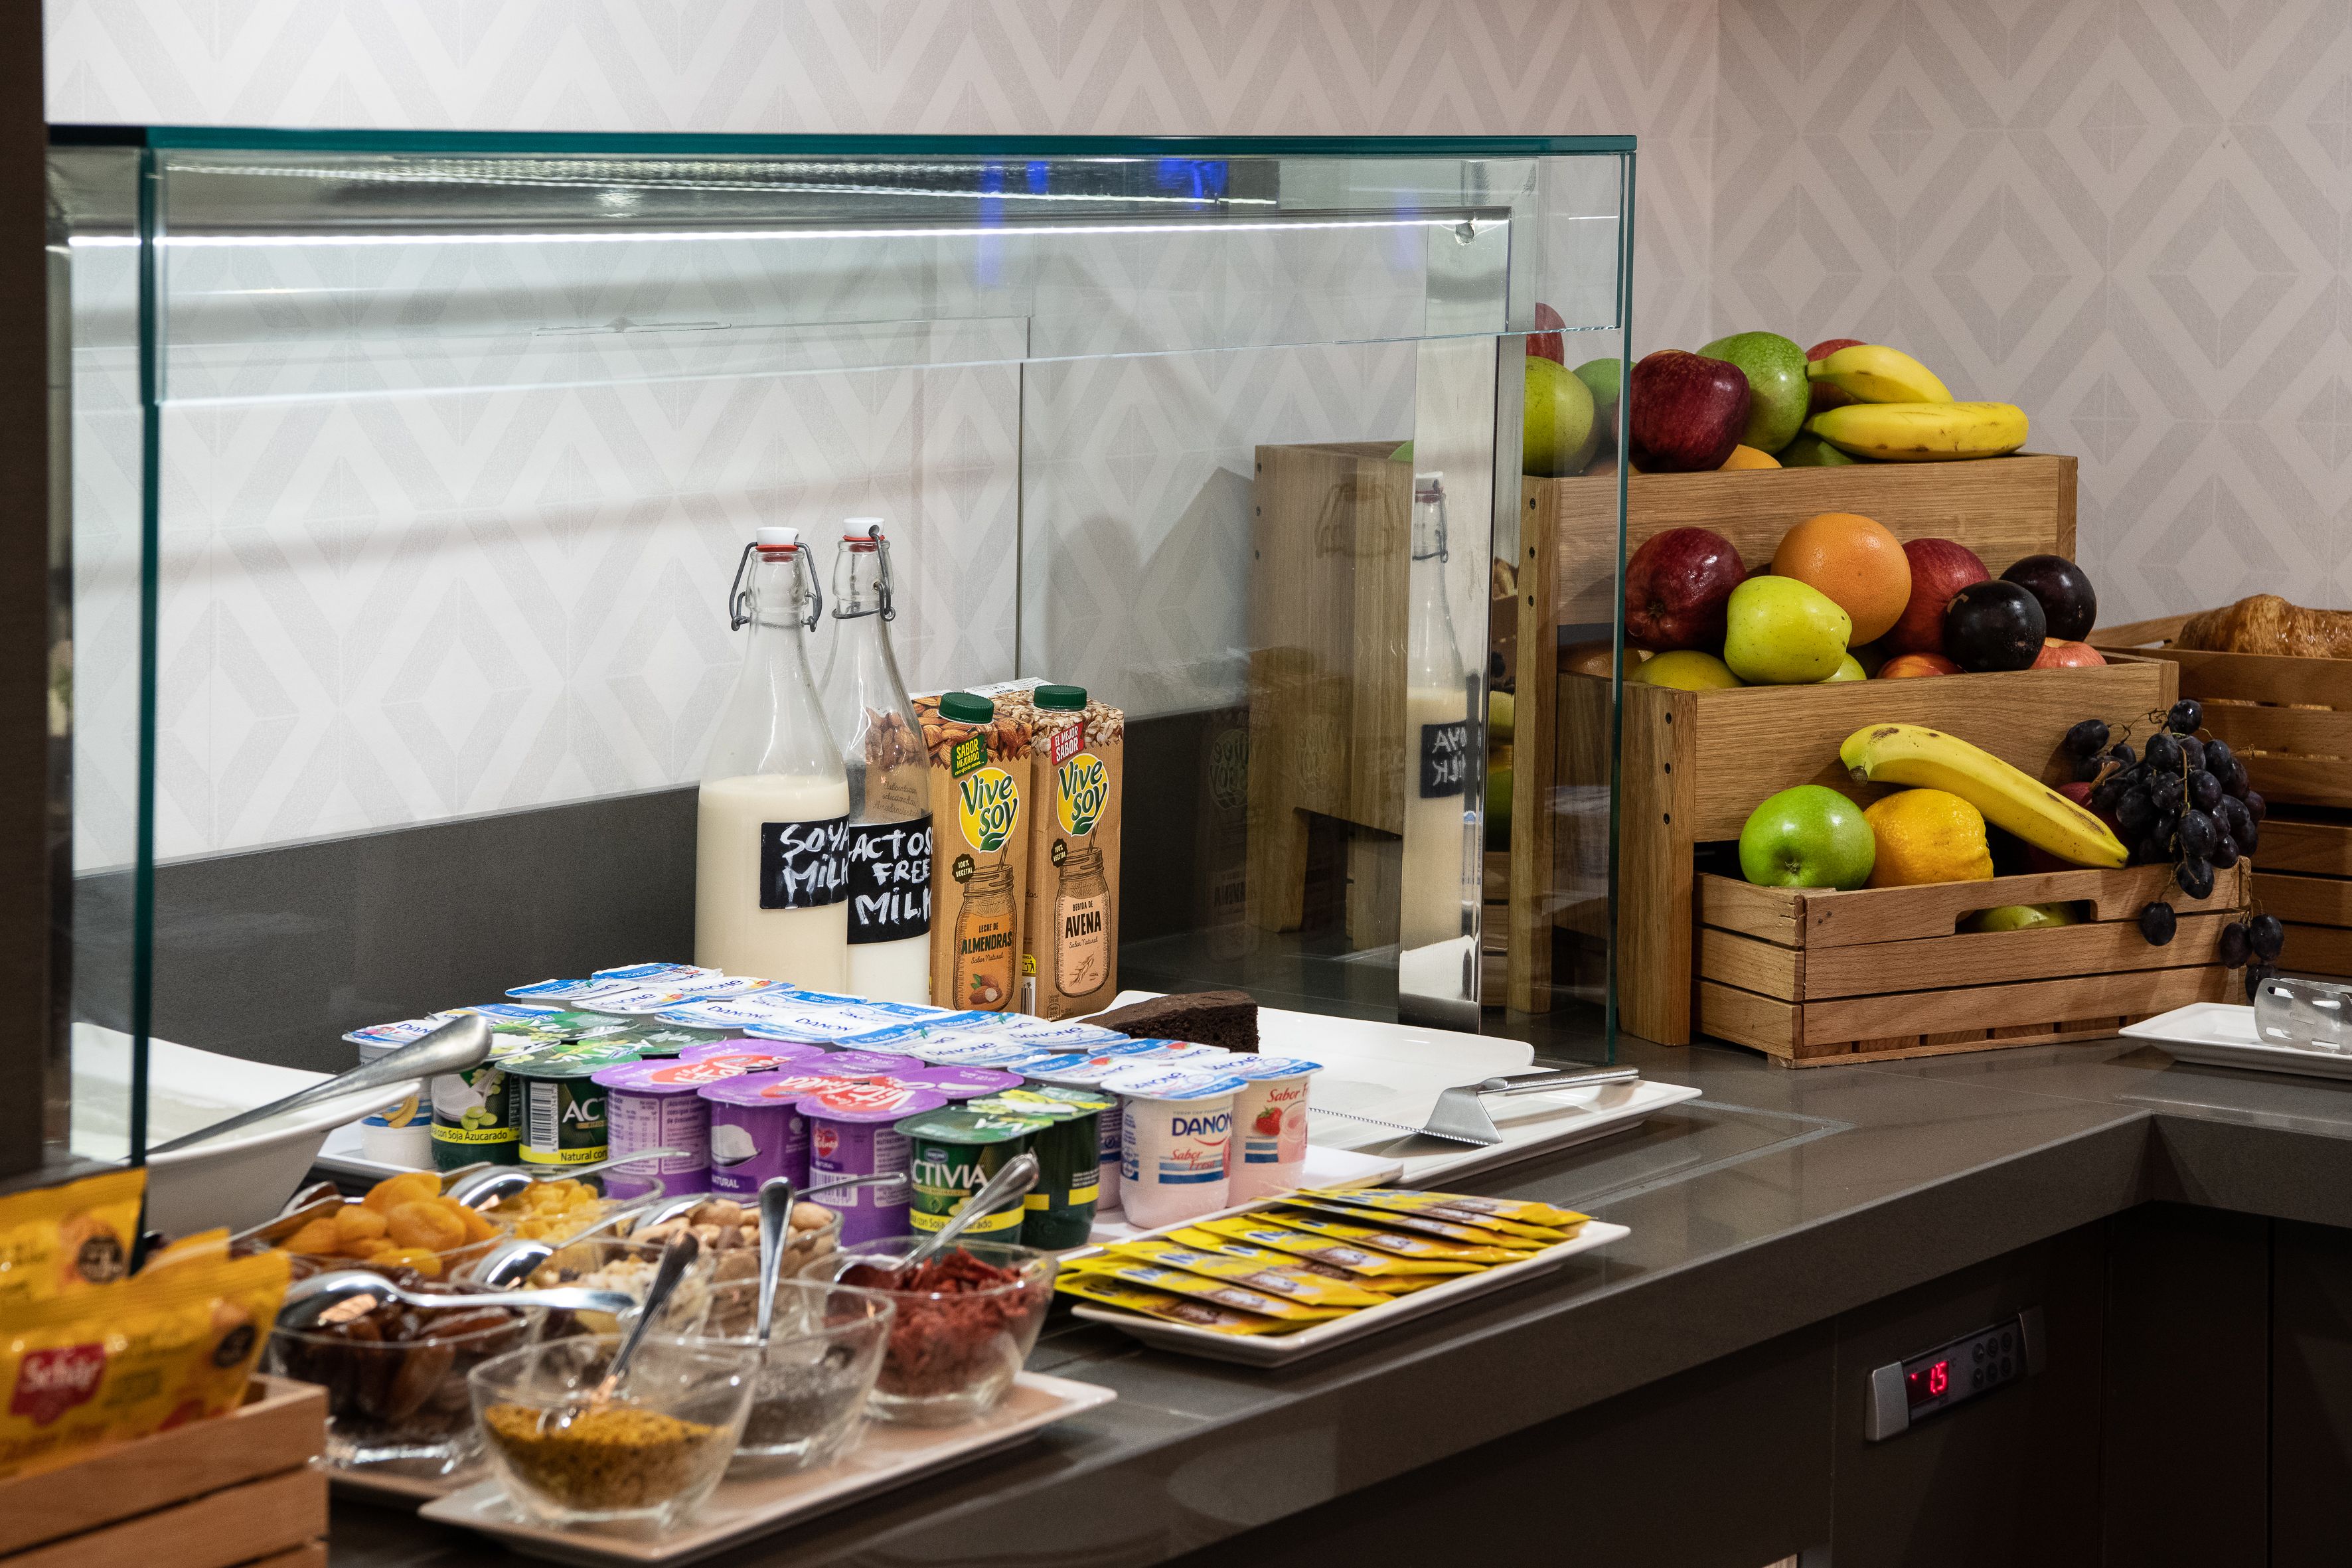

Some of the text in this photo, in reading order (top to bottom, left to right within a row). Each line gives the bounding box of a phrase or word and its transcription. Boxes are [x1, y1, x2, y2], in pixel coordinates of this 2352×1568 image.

[1056, 726, 1079, 747] EL MEJOR
[956, 738, 979, 760] SABOR
[1056, 737, 1079, 763] SABOR
[957, 751, 980, 769] MEJORADO
[1058, 761, 1103, 801] Vive
[959, 774, 1013, 815] Vive
[1071, 783, 1107, 821] soy
[979, 797, 1018, 838] soy
[958, 859, 970, 868] 100%
[1053, 852, 1066, 862] VEGETAL
[956, 868, 973, 878] VEGETAL
[1072, 900, 1093, 912] BEBIDA DE
[979, 923, 992, 933] LECHE
[1065, 910, 1102, 939] AVENA
[961, 931, 1013, 955] ALMENDRAS
[971, 951, 1004, 965] Sabor Natural
[1267, 1087, 1300, 1103] Sabor
[447, 1130, 463, 1142] Soja
[465, 1130, 508, 1142] Azucarado
[560, 1150, 592, 1162] Natural
[1171, 1149, 1204, 1160] Sabor
